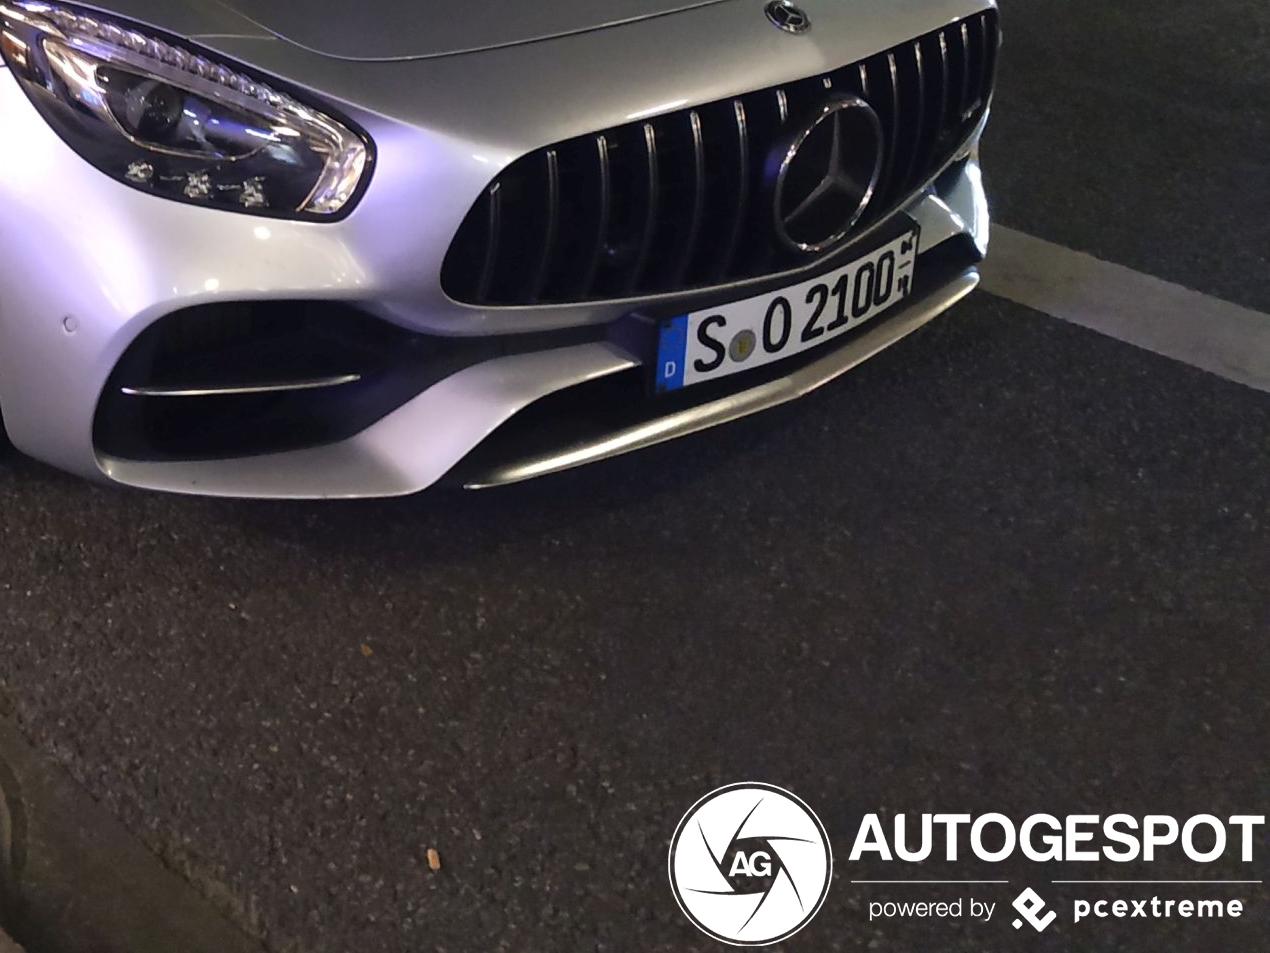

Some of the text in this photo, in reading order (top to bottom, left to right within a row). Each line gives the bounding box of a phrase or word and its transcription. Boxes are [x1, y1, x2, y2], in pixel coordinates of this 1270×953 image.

[693, 314, 727, 373] S
[800, 250, 895, 343] 2100
[664, 361, 676, 379] D
